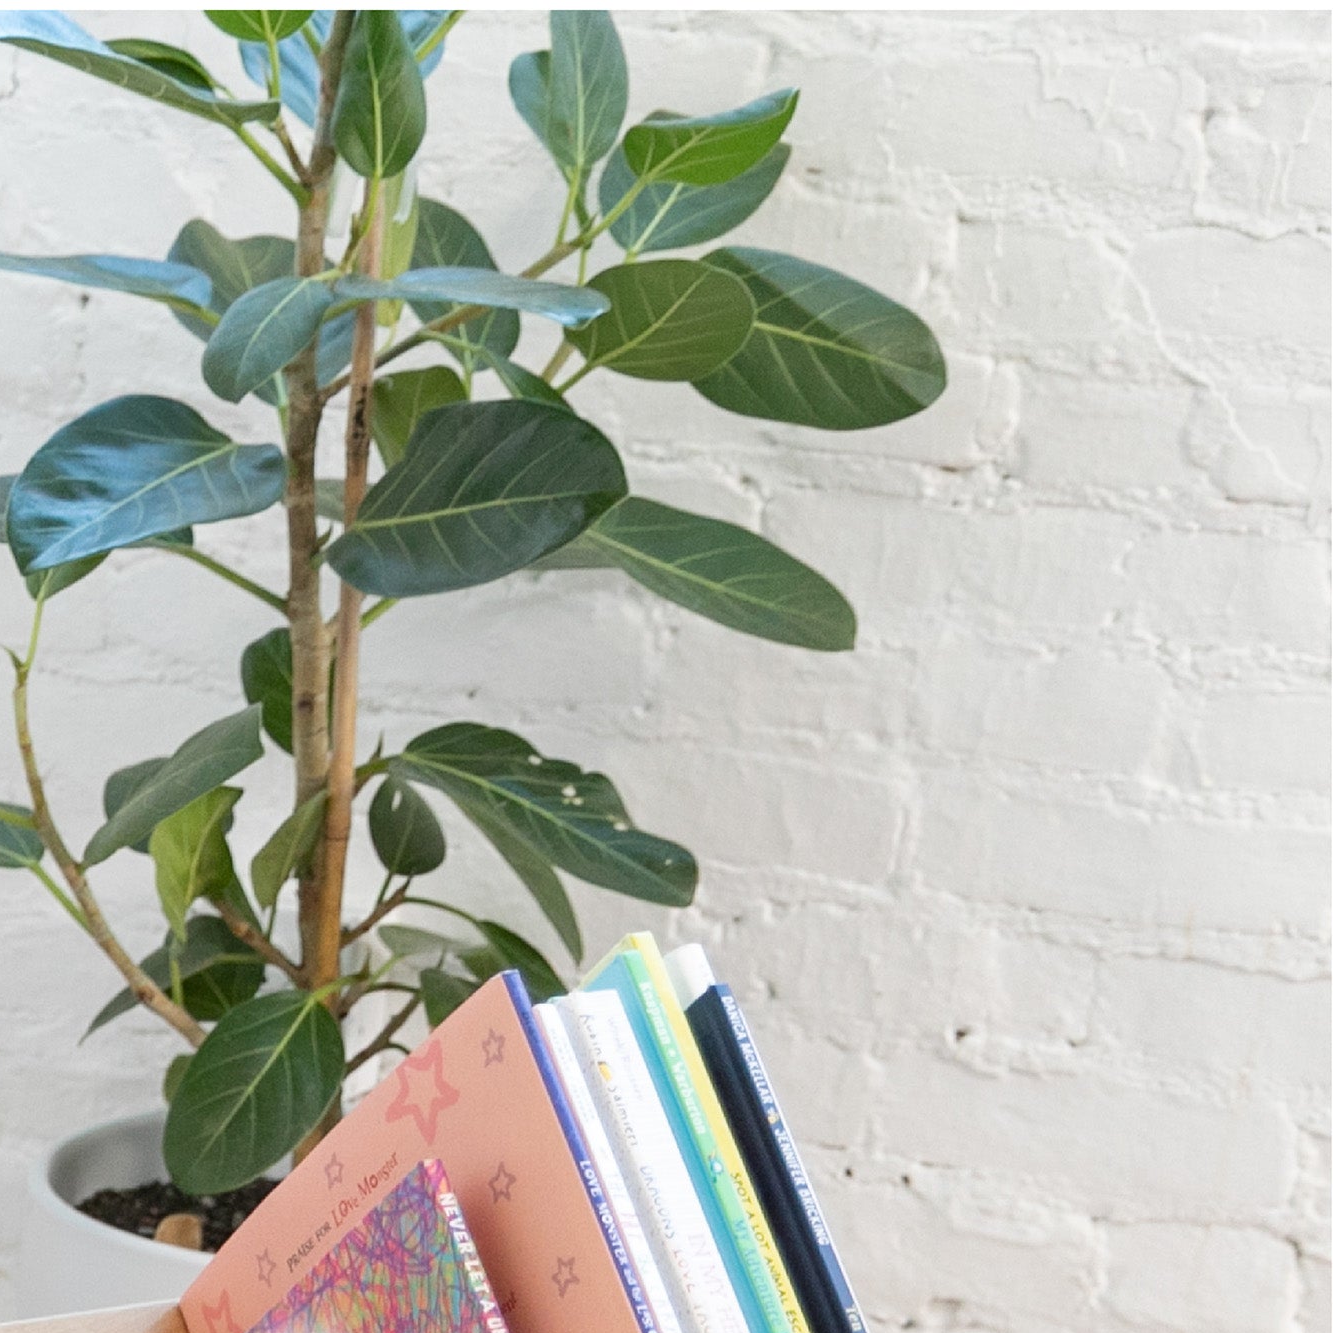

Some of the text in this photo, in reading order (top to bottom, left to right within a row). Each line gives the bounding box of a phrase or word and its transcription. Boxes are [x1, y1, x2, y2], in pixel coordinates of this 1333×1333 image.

[721, 995, 748, 1041] DANICA
[774, 1126, 806, 1188] JENNIFER
[797, 1185, 830, 1246] BRICKING
[286, 1222, 332, 1273] PRAISE FOR
[438, 1191, 475, 1254] NEVER
[466, 1259, 490, 1295] LET
[479, 1299, 496, 1313] A
[579, 1160, 599, 1197] LOVE
[596, 1200, 628, 1265] MONSTER
[731, 1172, 752, 1204] SPOT
[752, 1220, 771, 1251] LOT
[764, 1256, 789, 1312] ANIMAL
[747, 1240, 781, 1328] Adventure
[844, 1304, 863, 1333] Ten
